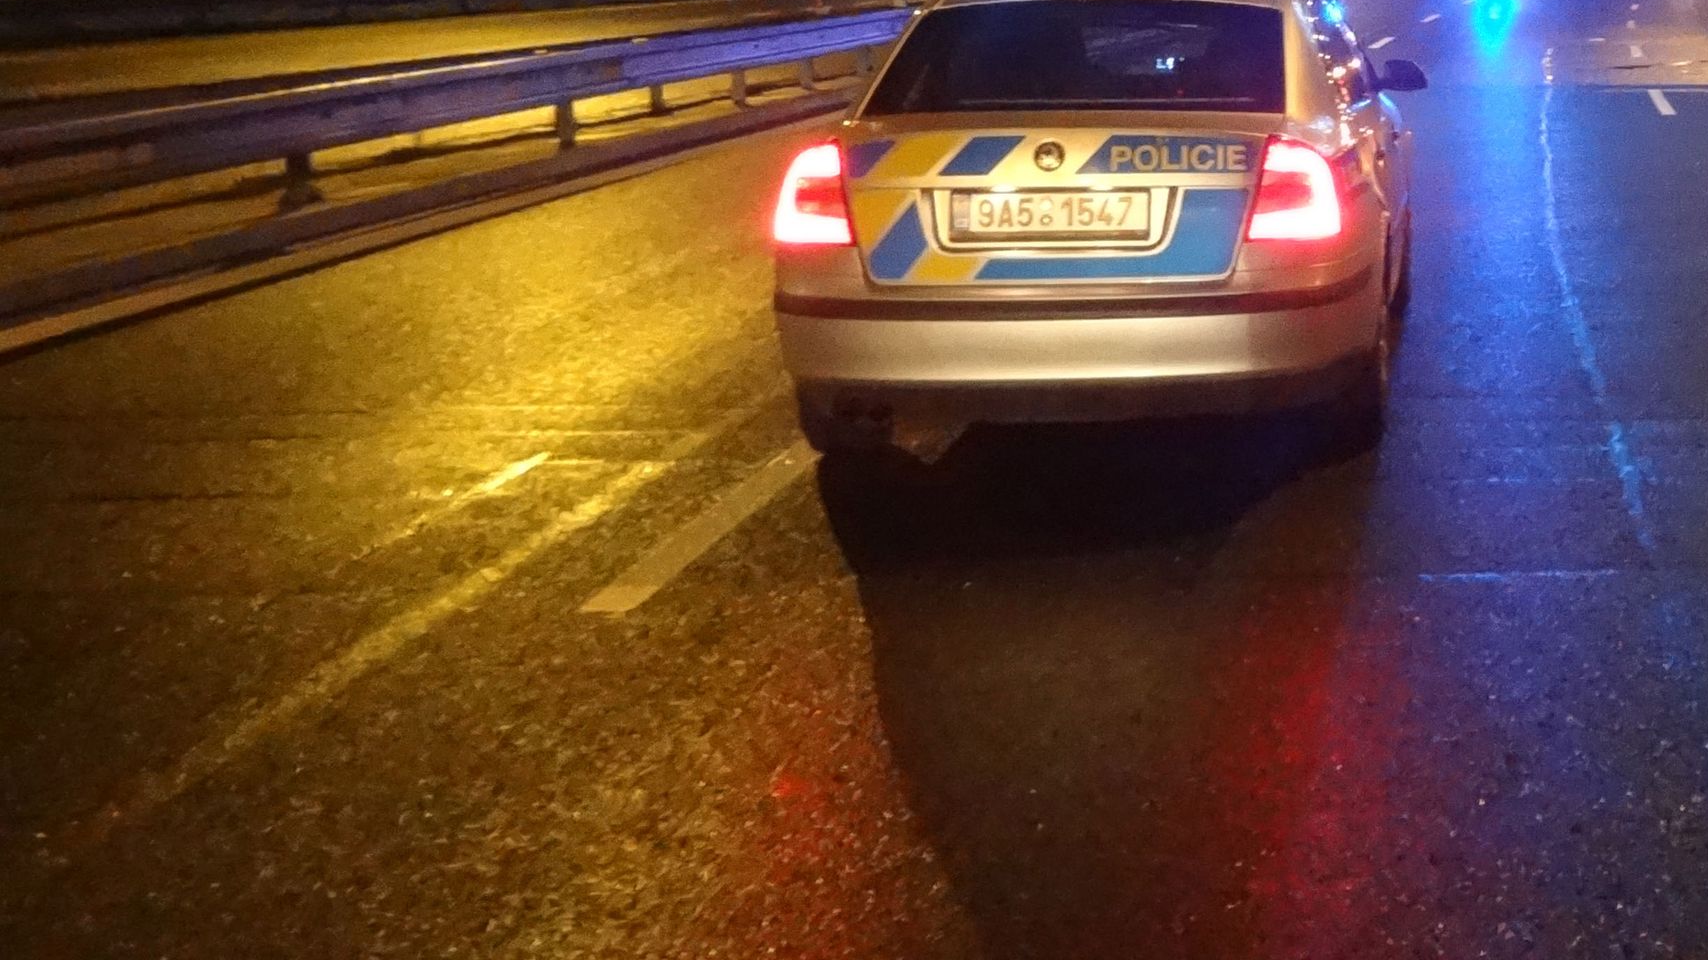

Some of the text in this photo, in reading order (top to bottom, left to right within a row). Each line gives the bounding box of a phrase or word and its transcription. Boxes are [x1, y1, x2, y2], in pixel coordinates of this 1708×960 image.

[1109, 143, 1248, 172] POLICIE
[977, 196, 1133, 228] 9A5 1547
